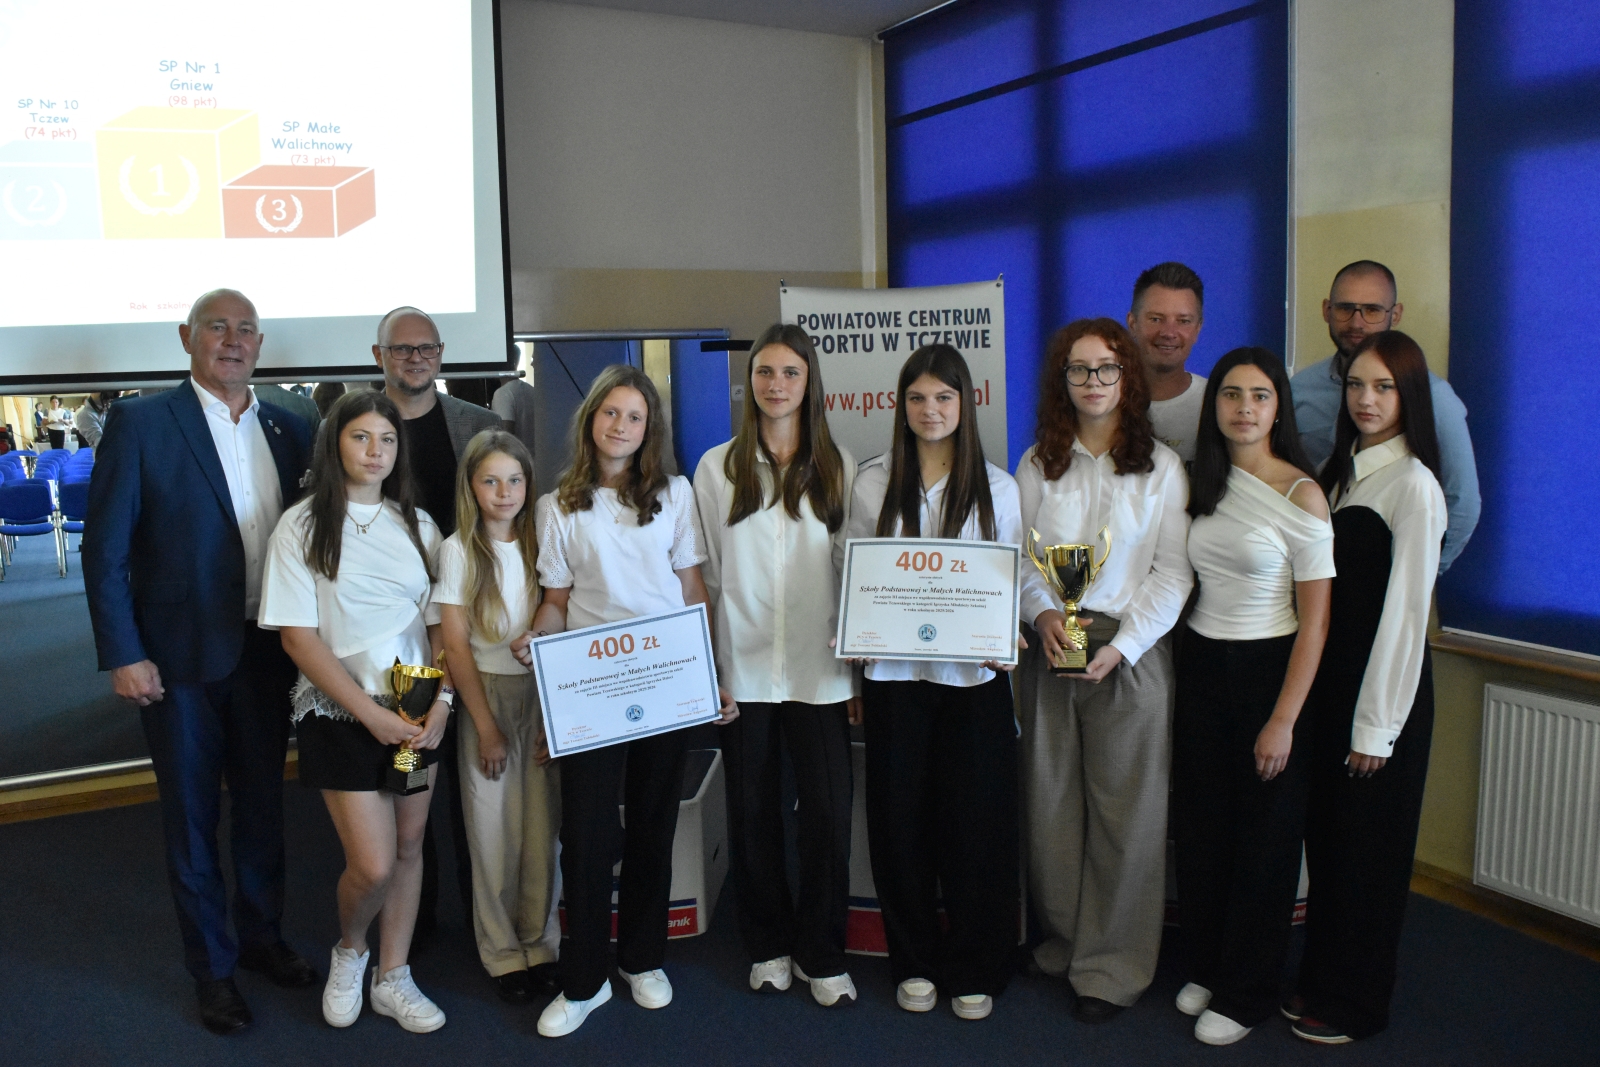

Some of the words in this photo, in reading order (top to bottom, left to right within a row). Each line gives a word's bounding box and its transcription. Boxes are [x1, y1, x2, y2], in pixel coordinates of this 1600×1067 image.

[158, 60, 179, 74] SP
[185, 61, 206, 75] Nr
[213, 62, 222, 75] 1
[169, 78, 215, 93] Gniew
[17, 99, 37, 110] SP
[40, 99, 58, 110] Nr
[63, 99, 80, 110] 10
[167, 95, 189, 108] (98
[192, 96, 218, 109] pkt)
[29, 112, 71, 125] Tczew
[24, 126, 48, 140] (74
[52, 127, 78, 141] pkt)
[281, 121, 301, 134] SP
[307, 122, 342, 135] Małe
[271, 138, 354, 154] Walichnowy
[290, 155, 311, 167] (73
[314, 155, 337, 168] pkt)
[148, 163, 172, 197] 1
[25, 185, 46, 213] 2
[272, 199, 288, 222] 3
[129, 302, 148, 311] Rok
[157, 301, 192, 311] szkolny
[797, 311, 902, 330] POWIATOWE
[908, 308, 991, 327] CENTRUM
[809, 333, 874, 354] PORTU
[881, 332, 900, 353] W
[906, 329, 991, 351] TCZEWIE
[895, 551, 943, 572] 400
[950, 560, 968, 573] ZŁ
[859, 585, 880, 593] Szkoły
[880, 585, 922, 594] Podstawowej
[955, 588, 1003, 596] Walichnowach
[588, 633, 635, 661] 400
[641, 635, 661, 651] ZŁ
[557, 681, 578, 691] Szkoły
[579, 671, 620, 686] Podstawowej
[627, 665, 651, 676] Małych
[652, 655, 697, 670] Walichnowach
